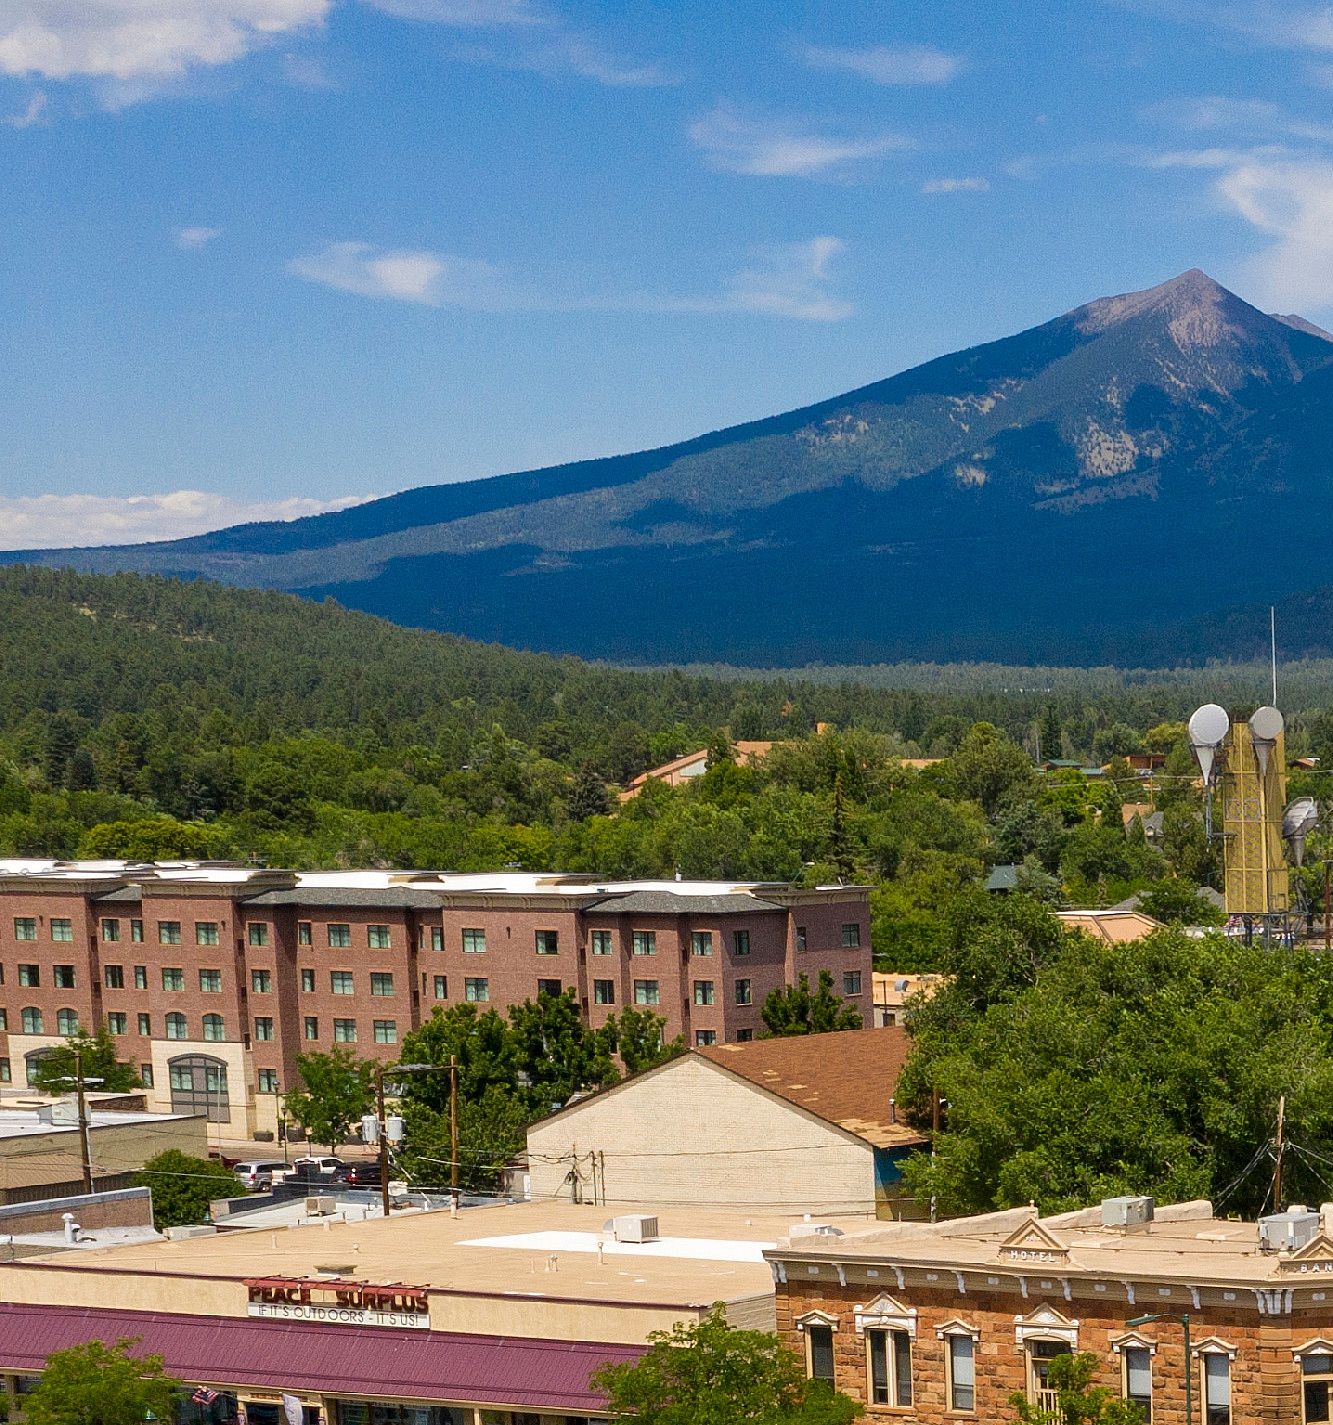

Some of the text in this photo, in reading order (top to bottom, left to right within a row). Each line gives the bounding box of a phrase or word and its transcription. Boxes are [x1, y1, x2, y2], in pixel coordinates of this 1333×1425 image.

[1010, 1250, 1056, 1263] HOTEL
[248, 1286, 429, 1315] PEACE SURPLUS
[258, 1305, 267, 1315] IF
[271, 1305, 290, 1317] IT'S
[293, 1307, 365, 1323] OUTDOORS
[377, 1313, 397, 1325] IT'S
[400, 1314, 419, 1326] US!
